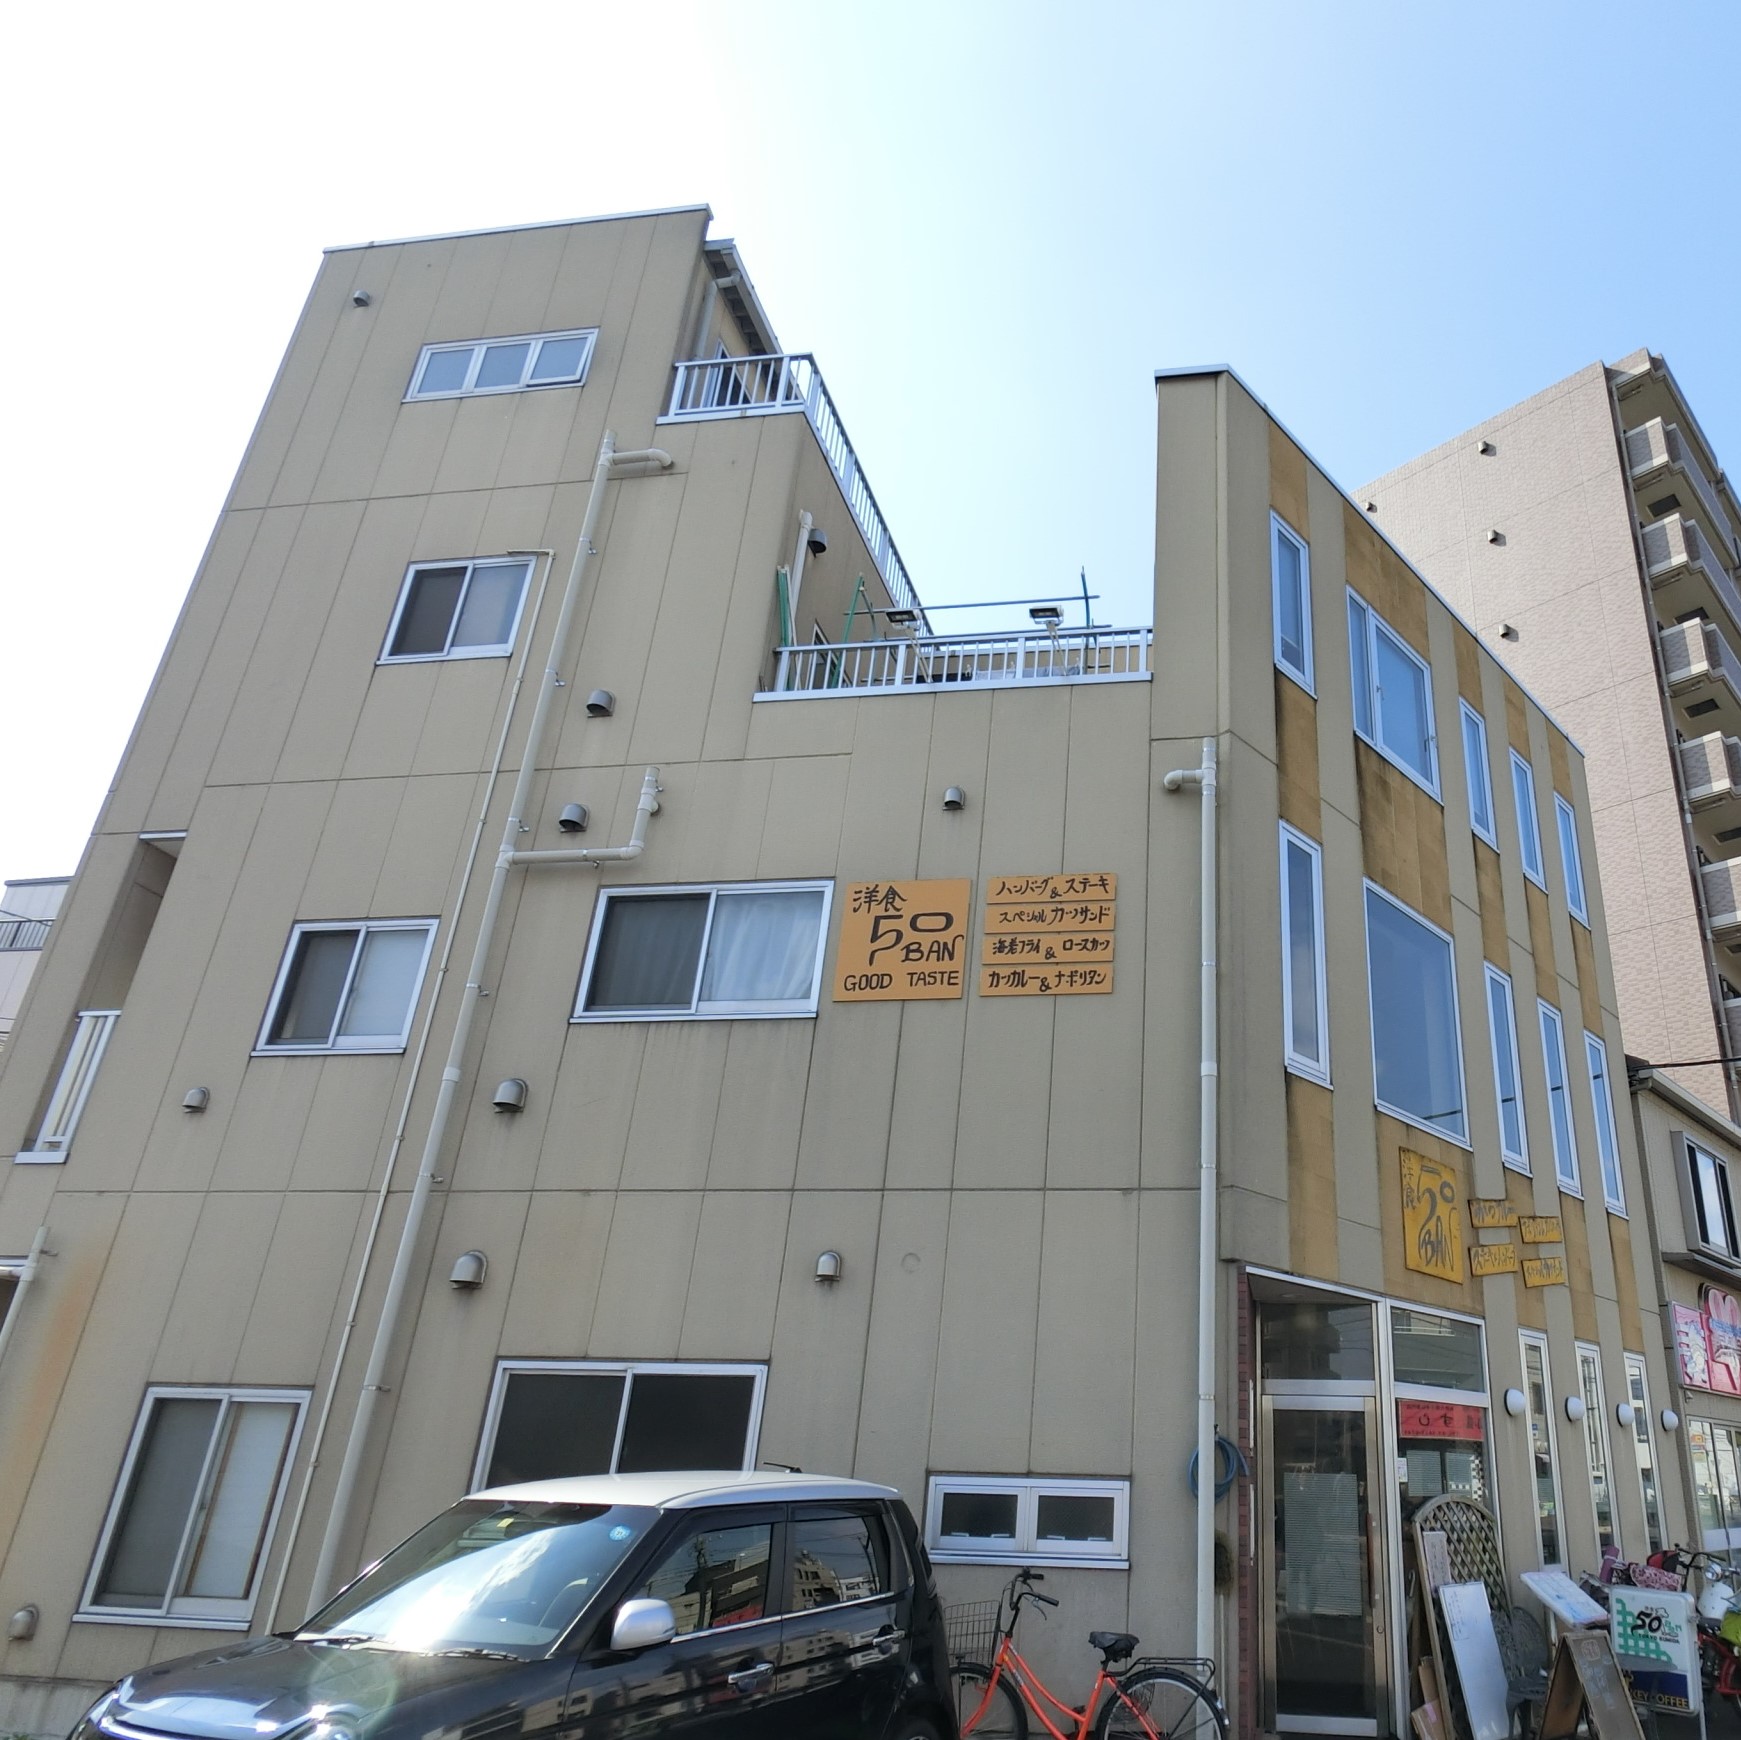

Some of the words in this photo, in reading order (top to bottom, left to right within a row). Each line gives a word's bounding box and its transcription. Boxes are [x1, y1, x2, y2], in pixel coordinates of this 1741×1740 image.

[852, 884, 908, 914] 洋食
[868, 912, 954, 967] 50
[900, 934, 965, 963] BAN
[992, 937, 1041, 955] 海老フライ
[1044, 946, 1057, 960] &
[1062, 938, 1111, 952] ロースカツ
[844, 973, 893, 992] GOOD
[906, 970, 960, 987] TASTE
[1631, 1610, 1662, 1636] 50
[1656, 1693, 1689, 1708] OFFEE
